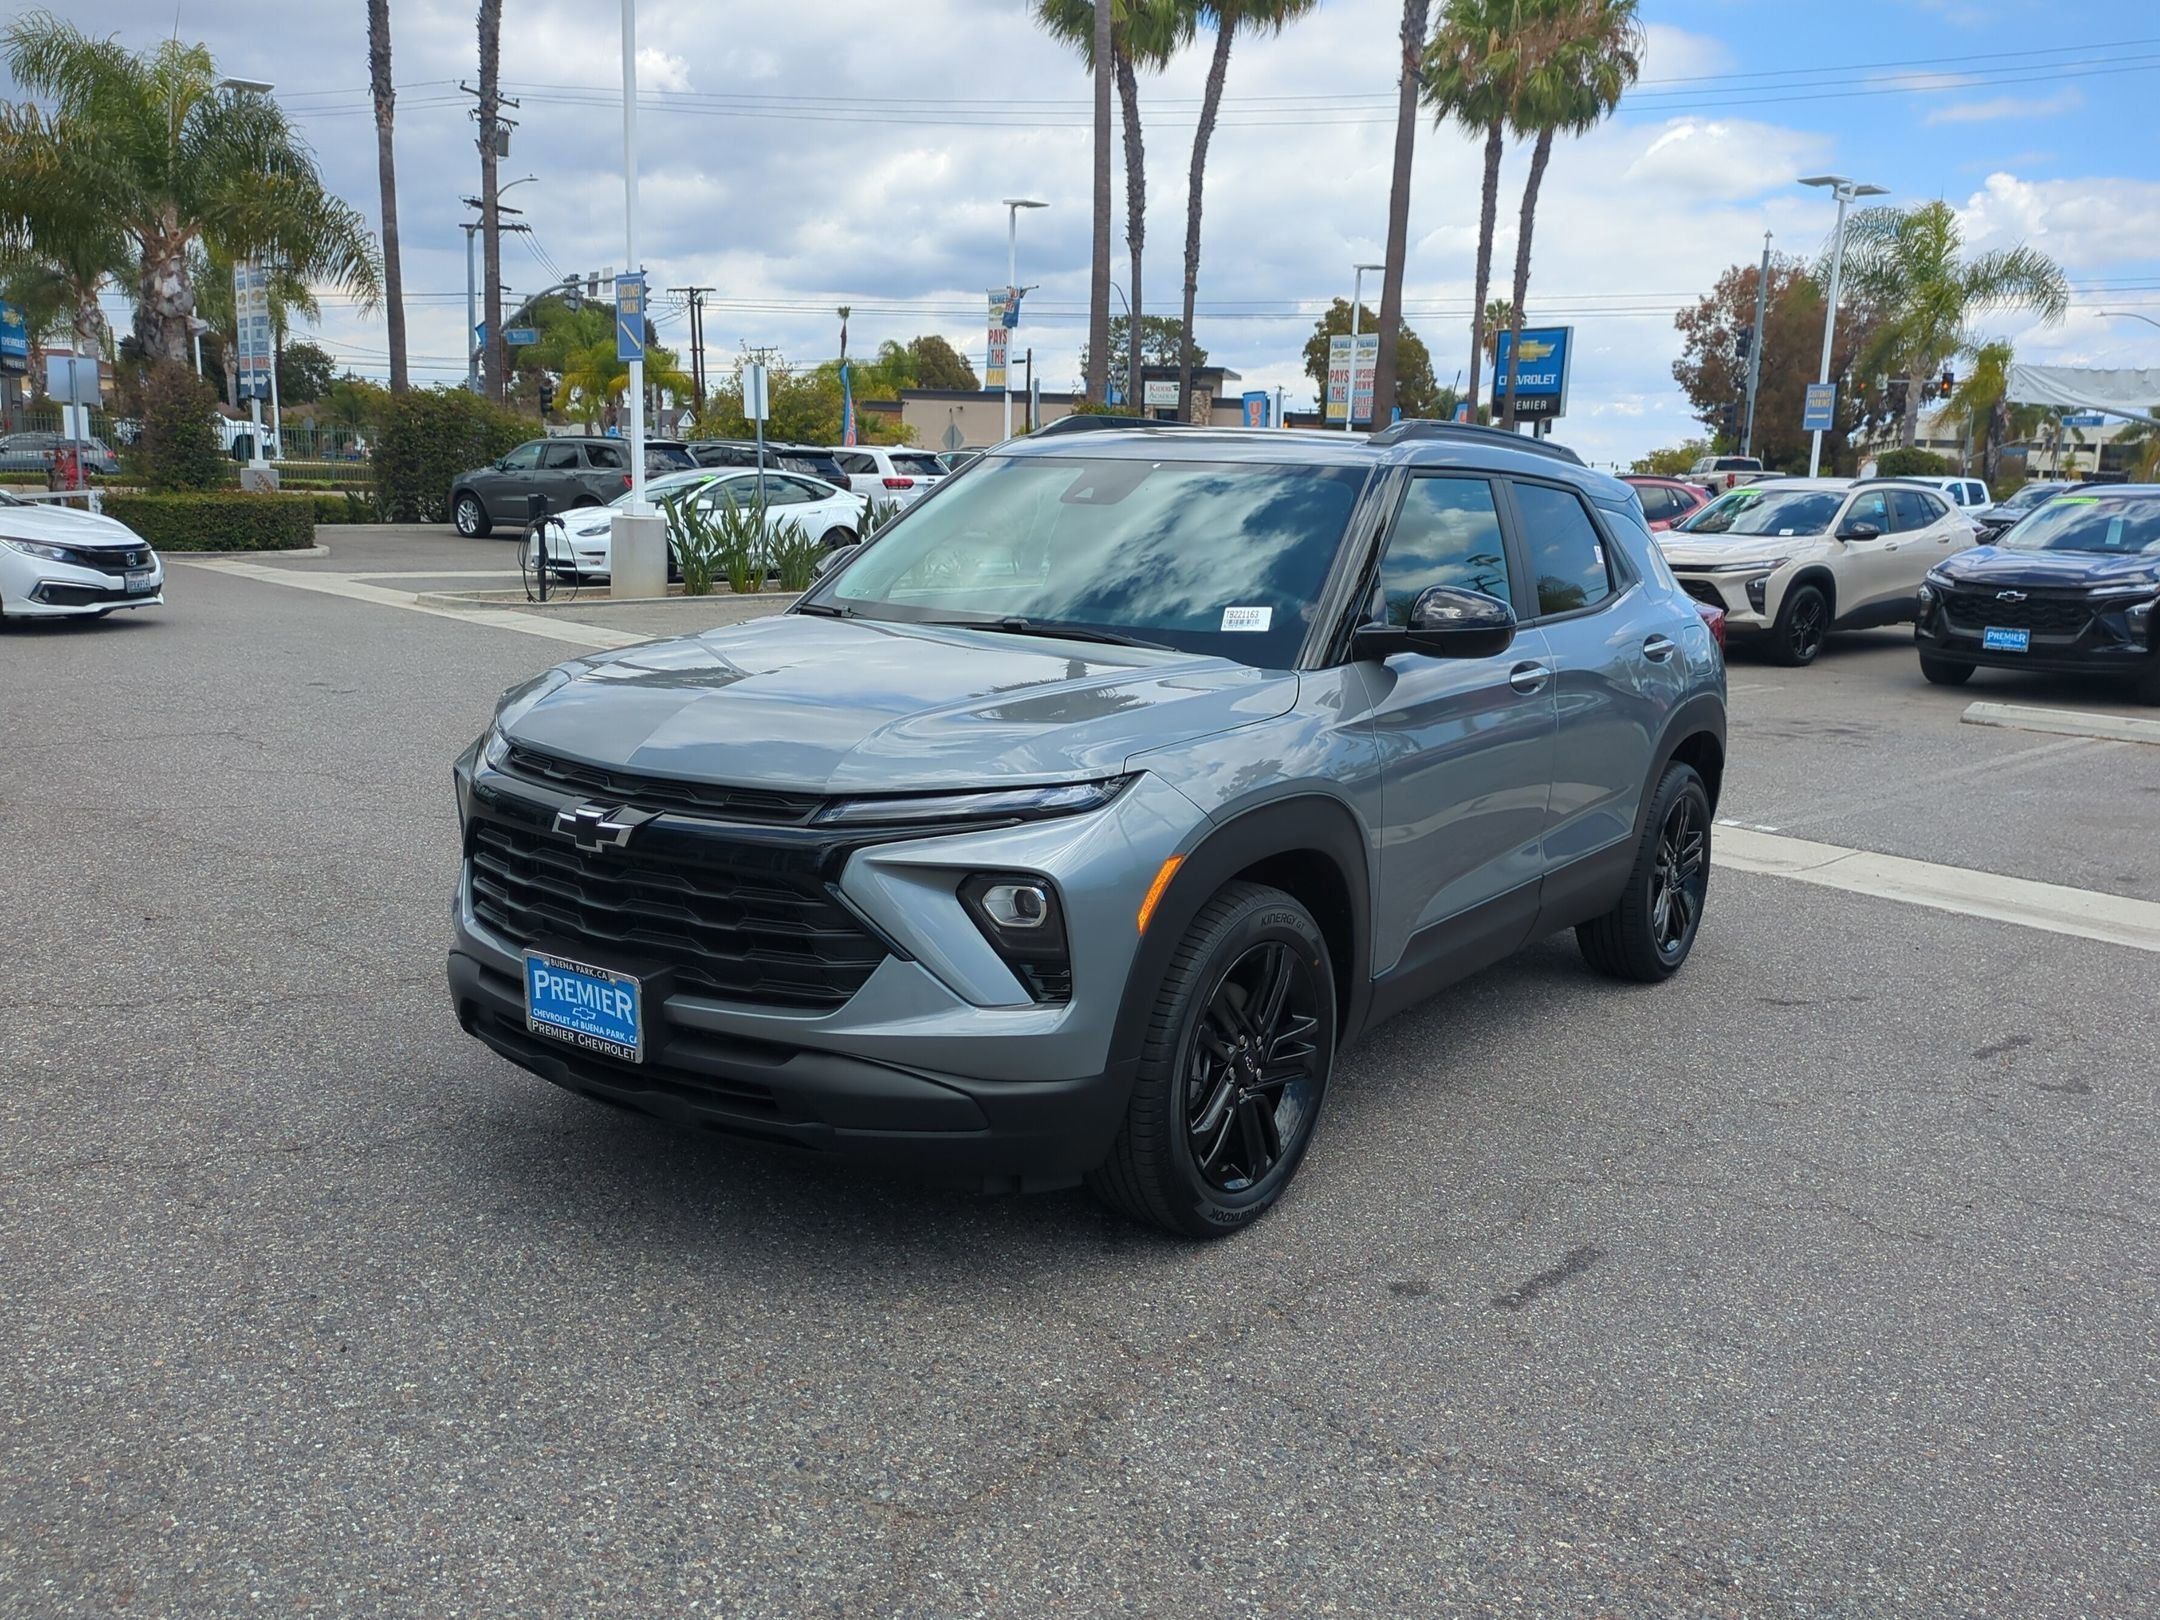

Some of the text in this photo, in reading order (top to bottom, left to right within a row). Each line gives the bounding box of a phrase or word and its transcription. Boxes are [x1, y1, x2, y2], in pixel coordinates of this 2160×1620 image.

[620, 300, 639, 313] PARKING
[989, 329, 1007, 345] PAYS
[991, 348, 1004, 364] THE
[1330, 369, 1349, 383] PAYS
[1498, 374, 1556, 386] CVROLET
[1332, 386, 1345, 400] THE
[1987, 631, 2026, 643] PREMIER
[550, 958, 574, 971] BUENA
[533, 969, 635, 1026] PREMIER
[533, 1008, 570, 1025] CHEVROLET
[571, 1018, 579, 1027] of
[580, 1021, 605, 1036] BUENA
[606, 1029, 628, 1042] PARK,
[532, 1020, 636, 1061] PREMIER CHEVROLET
